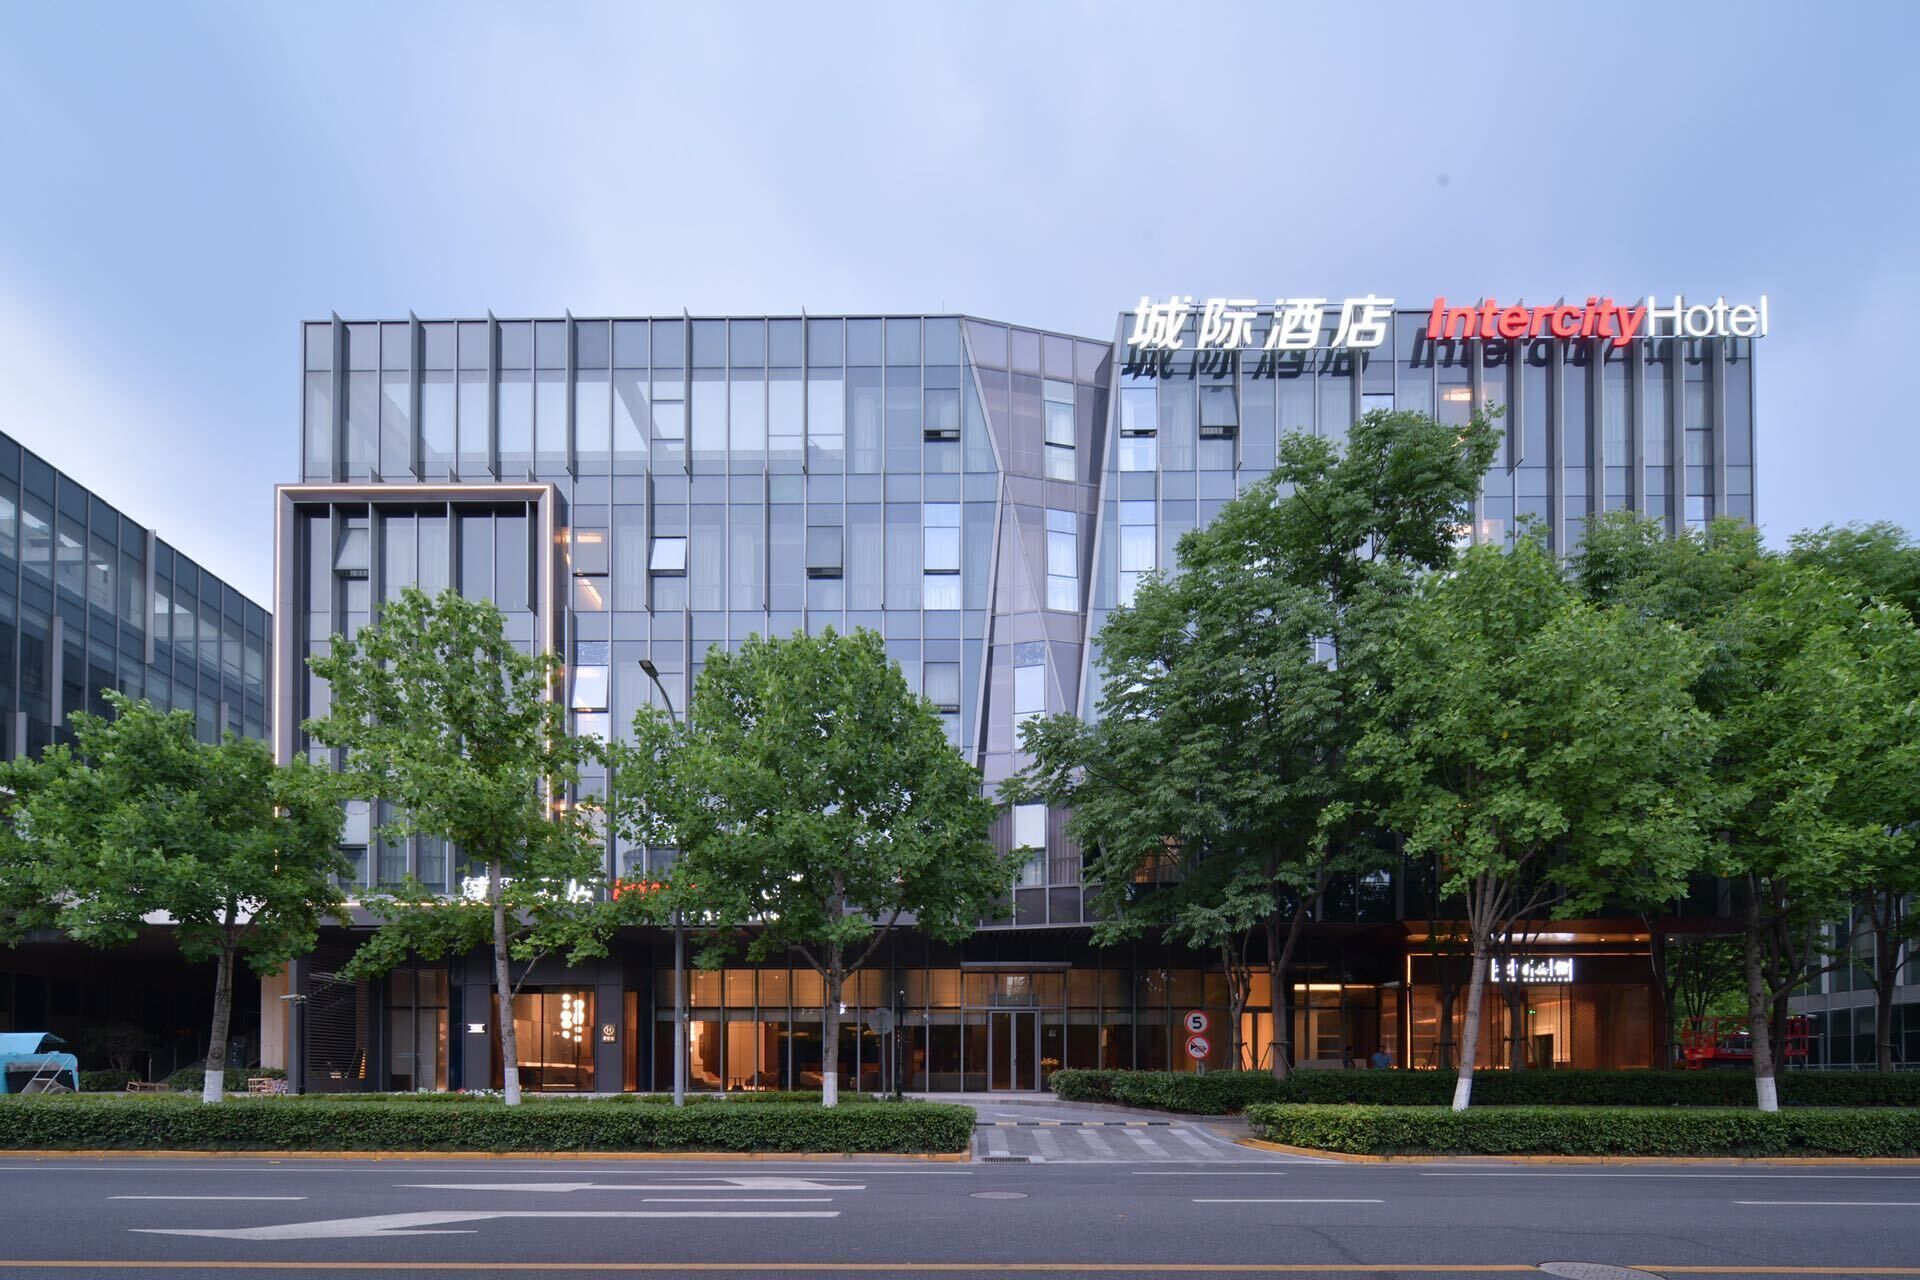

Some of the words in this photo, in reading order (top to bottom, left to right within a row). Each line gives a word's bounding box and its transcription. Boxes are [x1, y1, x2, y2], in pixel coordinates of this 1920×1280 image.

[1127, 294, 1395, 350] 城际酒店
[1192, 1016, 1203, 1030] 5
